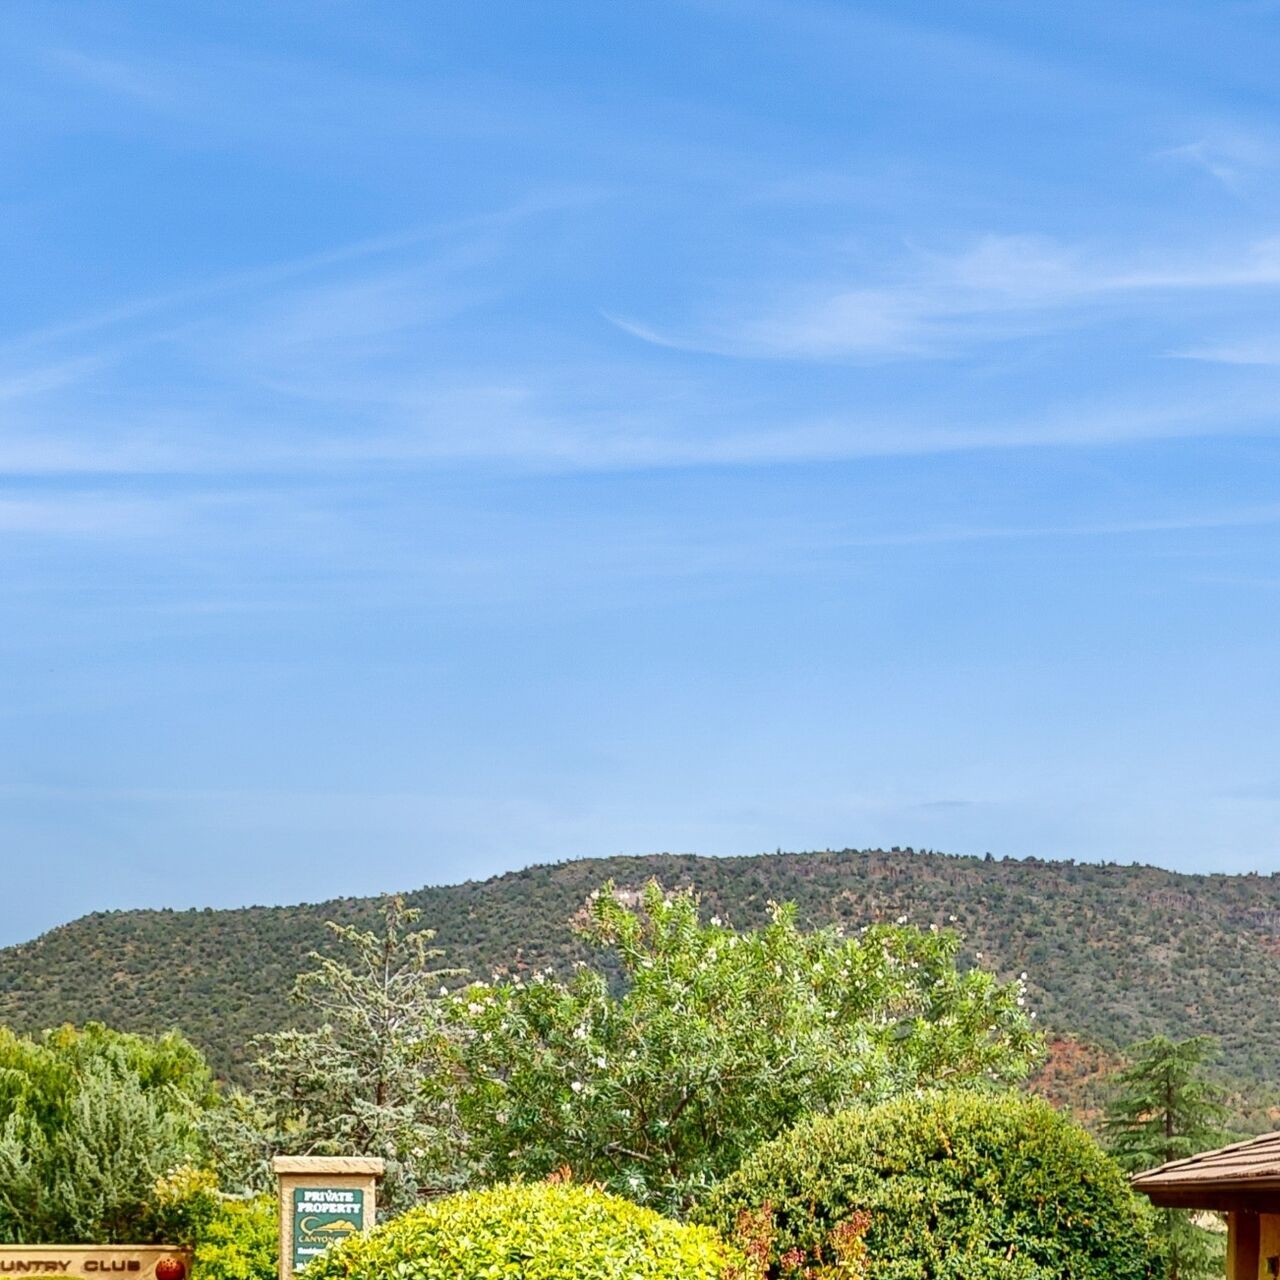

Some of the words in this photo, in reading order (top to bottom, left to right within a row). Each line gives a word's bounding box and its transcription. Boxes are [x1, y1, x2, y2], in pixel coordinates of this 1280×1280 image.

[304, 1191, 354, 1202] PRIVATE
[297, 1202, 361, 1213] PROPERTY
[83, 1260, 141, 1272] CLUB
